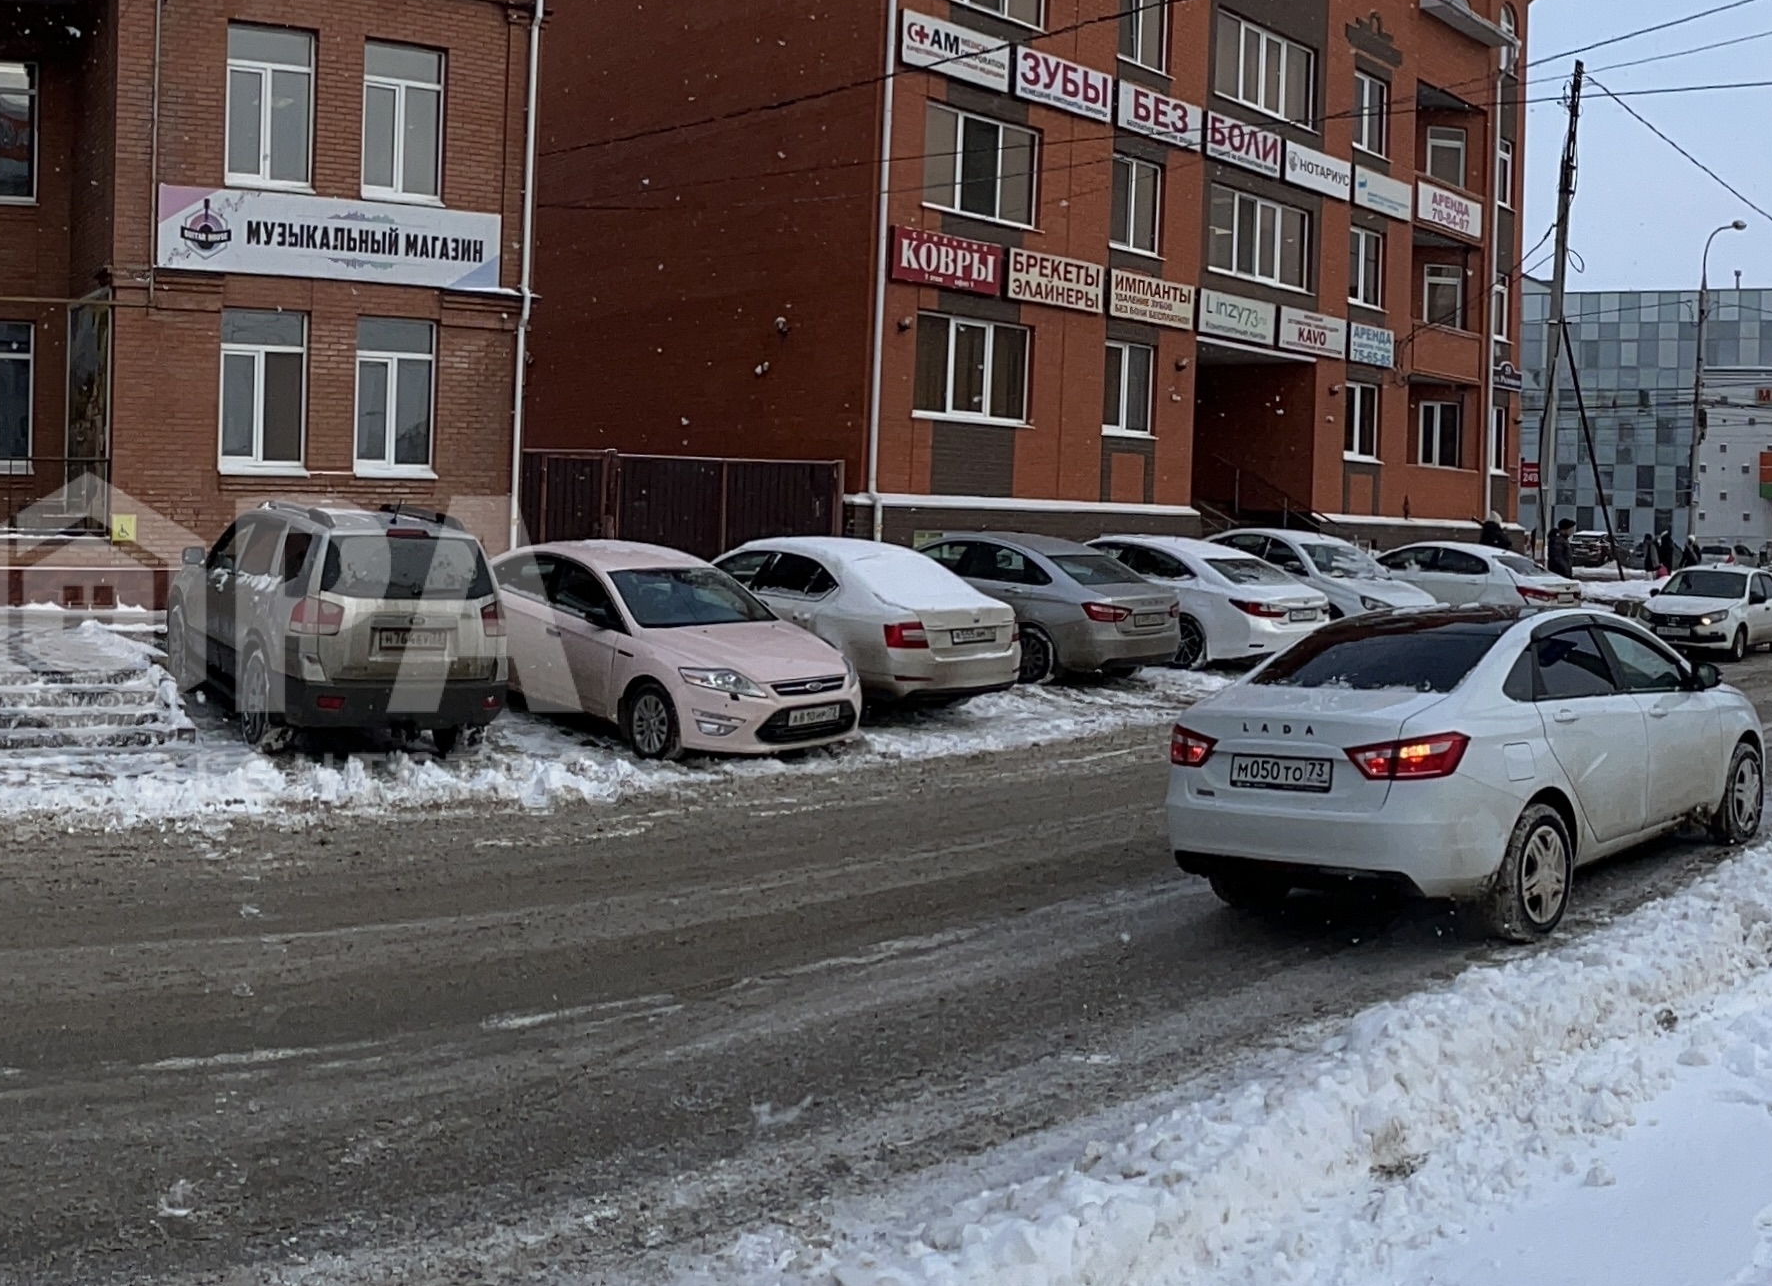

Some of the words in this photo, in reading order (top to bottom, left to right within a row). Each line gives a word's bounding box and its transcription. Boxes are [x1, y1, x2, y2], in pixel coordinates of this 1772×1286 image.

[1021, 52, 1108, 108] ЗУБЫ
[1134, 89, 1188, 133] БЕЗ
[1211, 116, 1278, 166] БОЛИ
[1300, 159, 1350, 187] НОТАРИУС
[1432, 192, 1470, 217] АРЕНДА
[247, 219, 399, 256] МУЗЫКАЛЬНЫЙ
[405, 233, 484, 262] МАГАЗИН
[900, 239, 996, 283] КОВРЫ
[1013, 252, 1100, 288] БРЕКЕТЫ
[1012, 278, 1099, 310] ЭЛАЙНЕРЫ
[1116, 275, 1191, 304] ИМПЛАНТЫ
[1298, 327, 1326, 346] KAVO
[1354, 325, 1391, 346] АРЕНДА
[1242, 721, 1314, 736] LADA
[1308, 762, 1325, 778] 73
